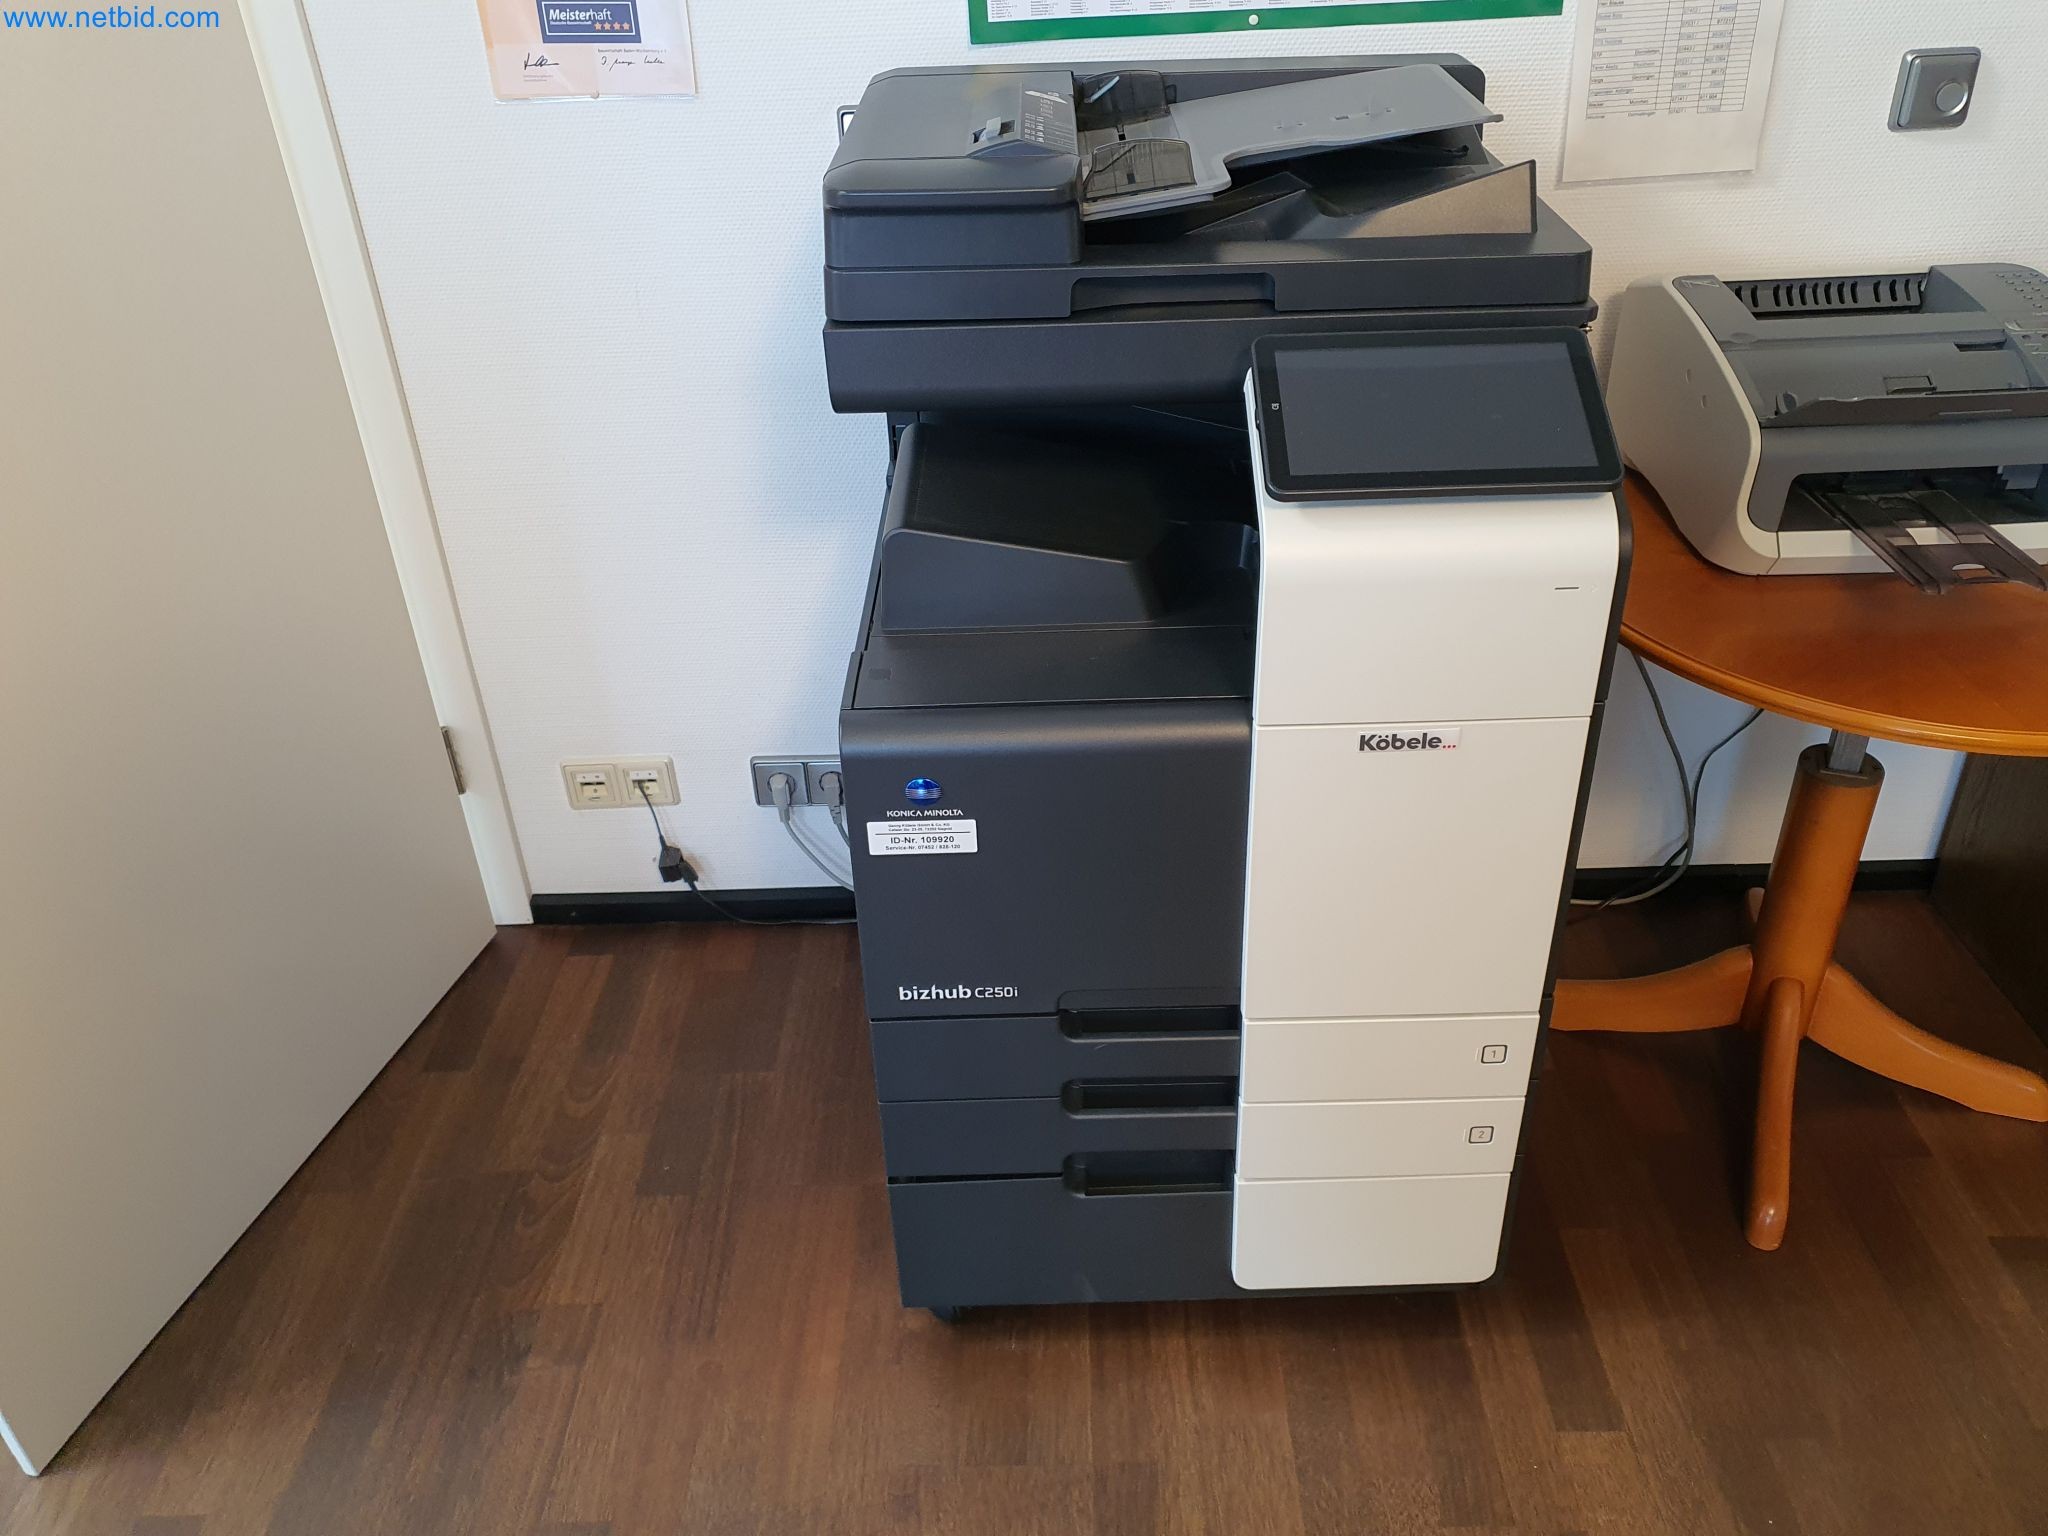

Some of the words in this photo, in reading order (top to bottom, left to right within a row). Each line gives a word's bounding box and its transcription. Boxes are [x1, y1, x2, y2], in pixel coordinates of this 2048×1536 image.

[549, 8, 612, 20] Meisterhaft
[886, 810, 923, 818] KONICA
[924, 809, 964, 817] MINOLTA
[890, 836, 918, 844] ID-Nr.
[921, 835, 955, 843] 109920
[898, 984, 972, 1001] bizhub
[974, 986, 1018, 998] C250i
[1491, 1050, 1497, 1058] 1
[1478, 1130, 1485, 1139] 2
